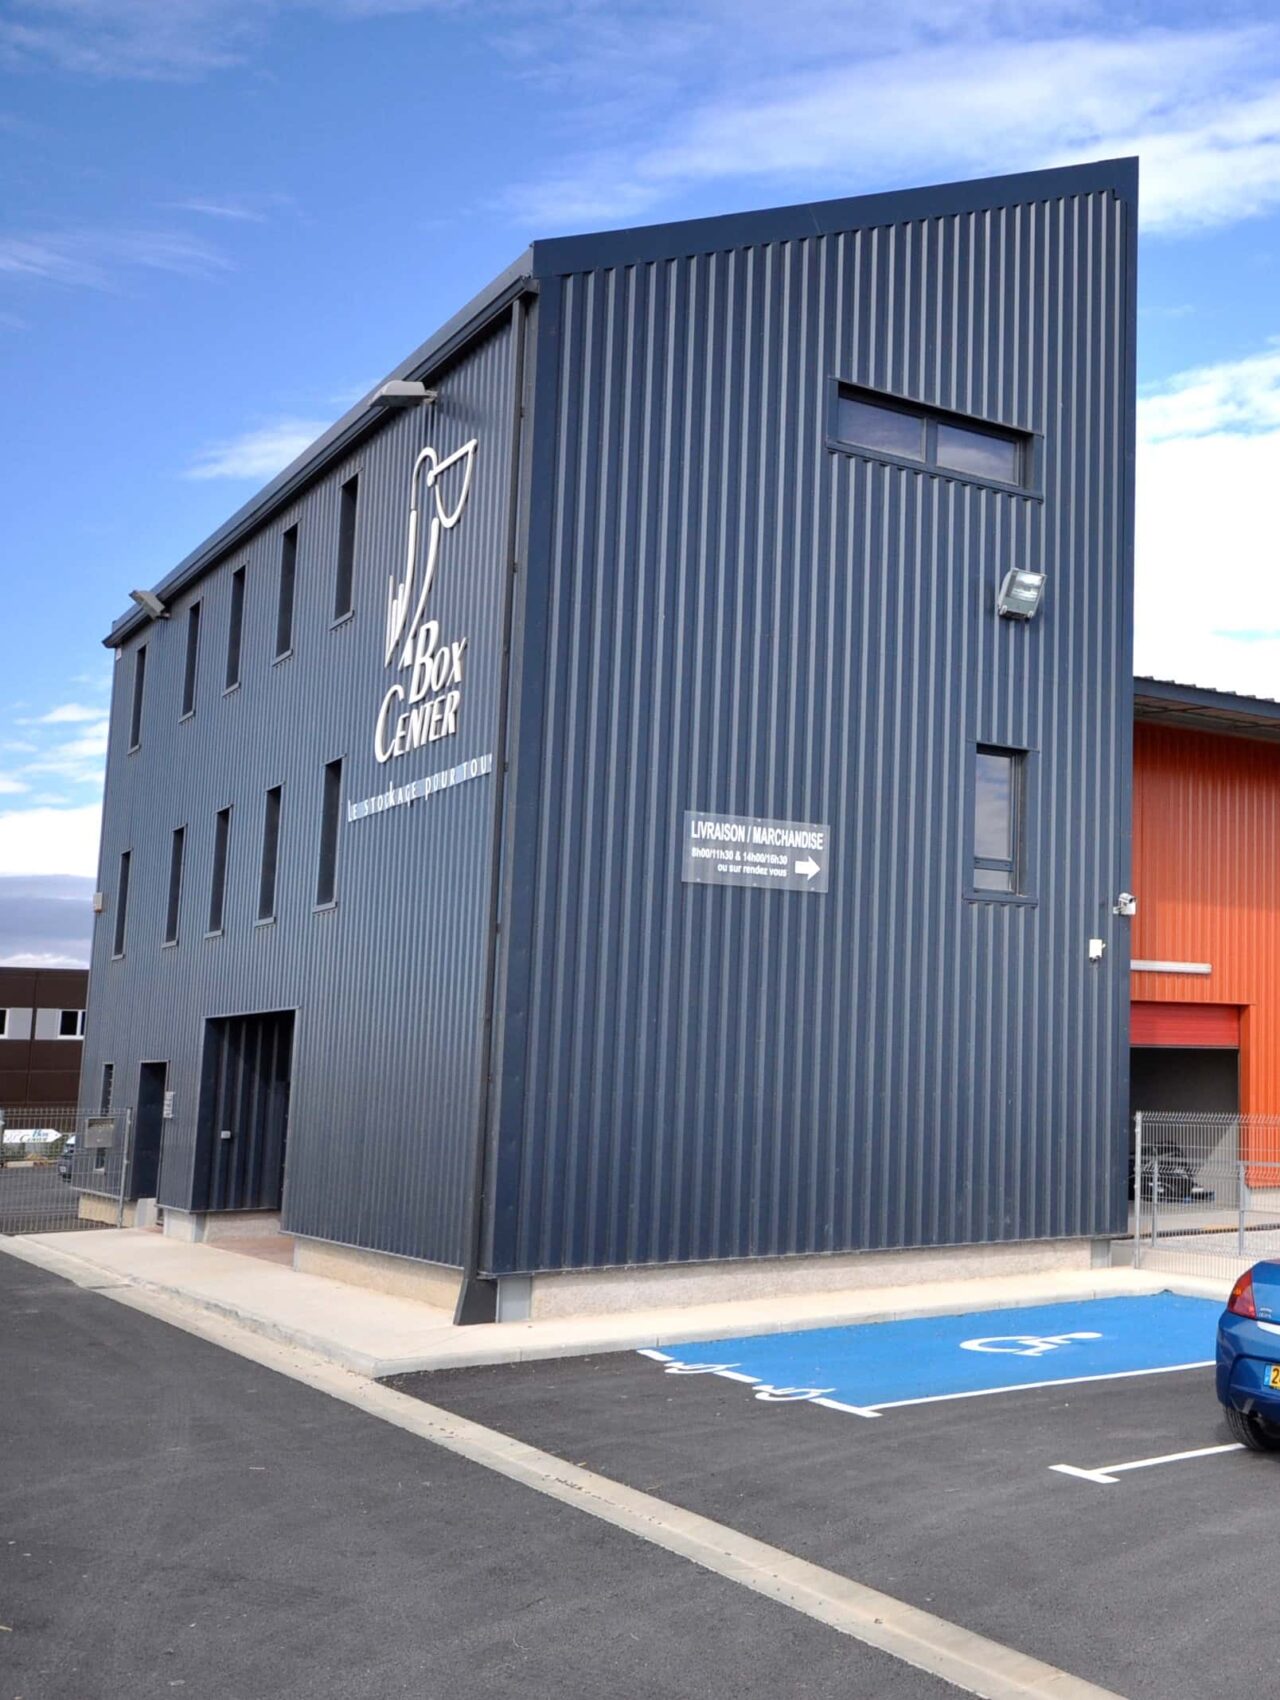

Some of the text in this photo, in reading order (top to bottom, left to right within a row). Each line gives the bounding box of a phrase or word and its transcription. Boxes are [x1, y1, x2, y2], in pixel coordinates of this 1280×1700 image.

[691, 820, 746, 843] LIVRAISON
[753, 826, 824, 850] MARCHANDISE
[735, 850, 741, 862] &
[717, 863, 787, 878] ou sur rendez vous
